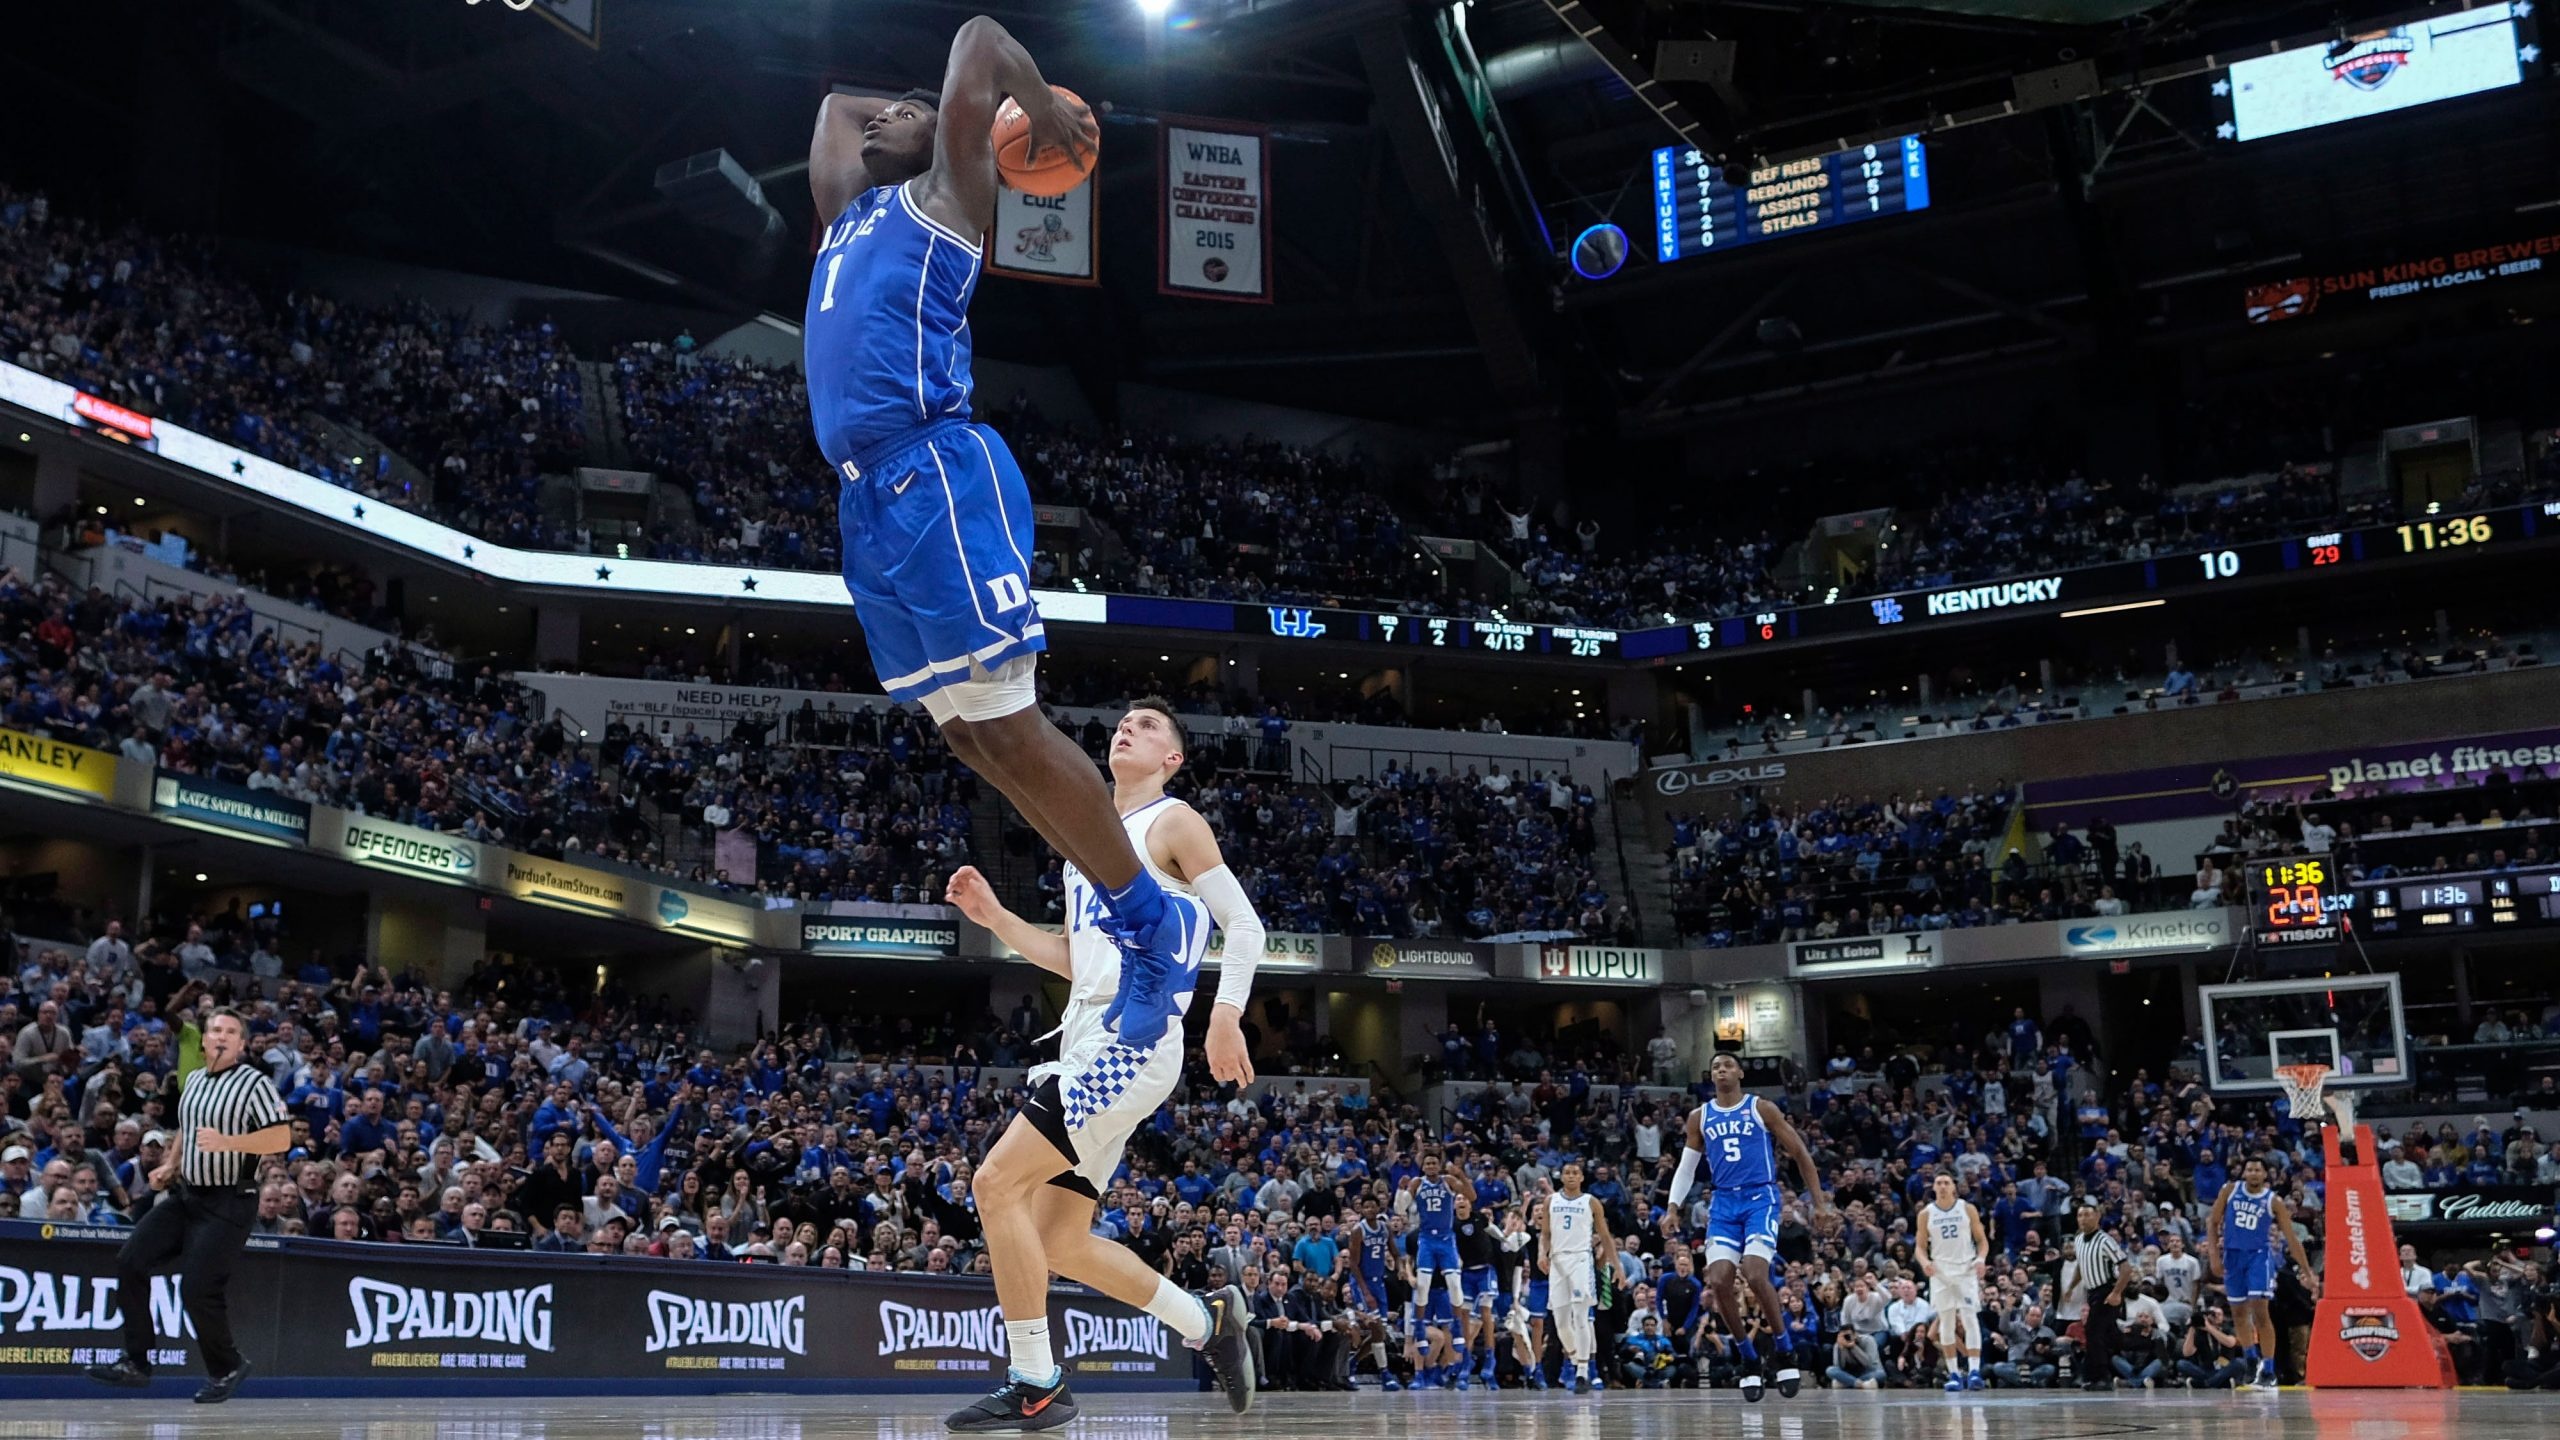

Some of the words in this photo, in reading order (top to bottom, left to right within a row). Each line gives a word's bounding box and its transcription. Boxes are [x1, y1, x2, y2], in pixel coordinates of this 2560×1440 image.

[1187, 142, 1243, 166] WNBA
[1863, 144, 1877, 160] 9
[1906, 136, 1920, 178] UKE
[1697, 164, 1711, 180] 0
[1751, 167, 1781, 186] DEF
[1782, 157, 1822, 178] REBS
[1861, 160, 1884, 178] 12
[1183, 171, 1247, 192] EASTERN
[1698, 181, 1711, 197] 7
[1747, 173, 1829, 203] REBOUNDS
[1866, 178, 1880, 195] 5
[1022, 191, 1067, 211] 2012
[1173, 187, 1257, 209] CONFERENCE
[1656, 152, 1675, 258] KENTUCKY
[1699, 197, 1712, 213] 7
[1757, 192, 1821, 219] ASSISTS
[1867, 196, 1880, 213] 1
[1175, 203, 1256, 225] CHAMPIONS
[1700, 215, 1714, 231] 2
[1761, 210, 1818, 235] STEALS
[1196, 229, 1235, 251] 2015
[1701, 231, 1714, 247] 0
[820, 253, 844, 312] 1
[2323, 269, 2375, 294] SUN
[2382, 256, 2448, 284] KING
[2369, 281, 2420, 300] FRESH
[2433, 268, 2486, 289] LOCAL
[2498, 258, 2542, 277] BEER
[2306, 532, 2343, 549] SHOT
[2396, 515, 2494, 553] 11:36
[2311, 545, 2342, 566] 29
[2199, 551, 2241, 581] 10
[1927, 577, 2063, 617] KENTUCKY
[1378, 614, 1399, 626] REB
[1428, 618, 1449, 630] AST
[1474, 622, 1501, 634] FIELD
[1502, 623, 1534, 636] GOALS
[1756, 612, 1778, 626] FLS
[1382, 625, 1395, 642] 7
[1432, 629, 1446, 646] 2
[1483, 633, 1526, 651] 4/13
[1552, 628, 1580, 640] FREE
[1580, 629, 1619, 642] THROWS
[1697, 632, 1711, 650] 3
[1761, 624, 1774, 640] 6
[1571, 639, 1601, 657] 2/5
[609, 700, 635, 712] Text
[671, 704, 716, 718] (space)
[676, 689, 724, 705] NEED
[727, 693, 782, 709] HELP?
[1691, 762, 1787, 787] LEXUS
[2329, 751, 2445, 792] planet
[178, 788, 209, 810] KATZ
[210, 793, 252, 819] SAPPER
[252, 806, 263, 820] &
[263, 808, 306, 831] MILLER
[345, 826, 452, 868] DEFENDERS
[507, 862, 624, 904] PurdueTeamStore.com
[2265, 861, 2325, 887] 11:36
[2421, 885, 2469, 906] 11:36
[2495, 880, 2507, 895] 4
[2268, 884, 2321, 925] 29
[2376, 890, 2388, 906] 3
[1073, 884, 1103, 933] 14
[804, 925, 865, 942] SPORT
[866, 928, 956, 945] GRAPHICS
[2127, 919, 2222, 939] Kinetico
[2279, 926, 2337, 942] TISSOT
[1399, 949, 1475, 967] LIGHTBOUND
[1805, 948, 1829, 961] Litz
[1830, 947, 1841, 960] &
[1842, 945, 1881, 959] Eaton
[1577, 949, 1647, 979] IUPUI
[1706, 1119, 1755, 1141] DUKE
[1722, 1137, 1742, 1162] 5
[1420, 1188, 1446, 1199] DUKE
[1426, 1198, 1442, 1212] 12
[1552, 1205, 1585, 1215] KENTUCKY
[2232, 1200, 2265, 1217] DUKE
[2438, 1194, 2543, 1220] Cadillac
[1562, 1214, 1572, 1230] 3
[1940, 1224, 1959, 1240] 22
[2234, 1213, 2258, 1231] 20
[1371, 1245, 1381, 1259] 2
[2173, 1277, 2184, 1289] 3
[346, 1275, 554, 1352] SPALDING
[646, 1289, 806, 1355] SPALDING
[878, 1300, 1006, 1357] SPALDING
[1064, 1308, 1169, 1360] SPALDING
[71, 1347, 95, 1365] ARE
[158, 1348, 188, 1366] GAME
[371, 1352, 440, 1368] #TRUEBELIEVERS
[440, 1352, 457, 1368] ARE
[457, 1352, 477, 1368] TRUE
[478, 1352, 489, 1368] TO
[489, 1352, 504, 1368] THE
[504, 1353, 527, 1369] GAME
